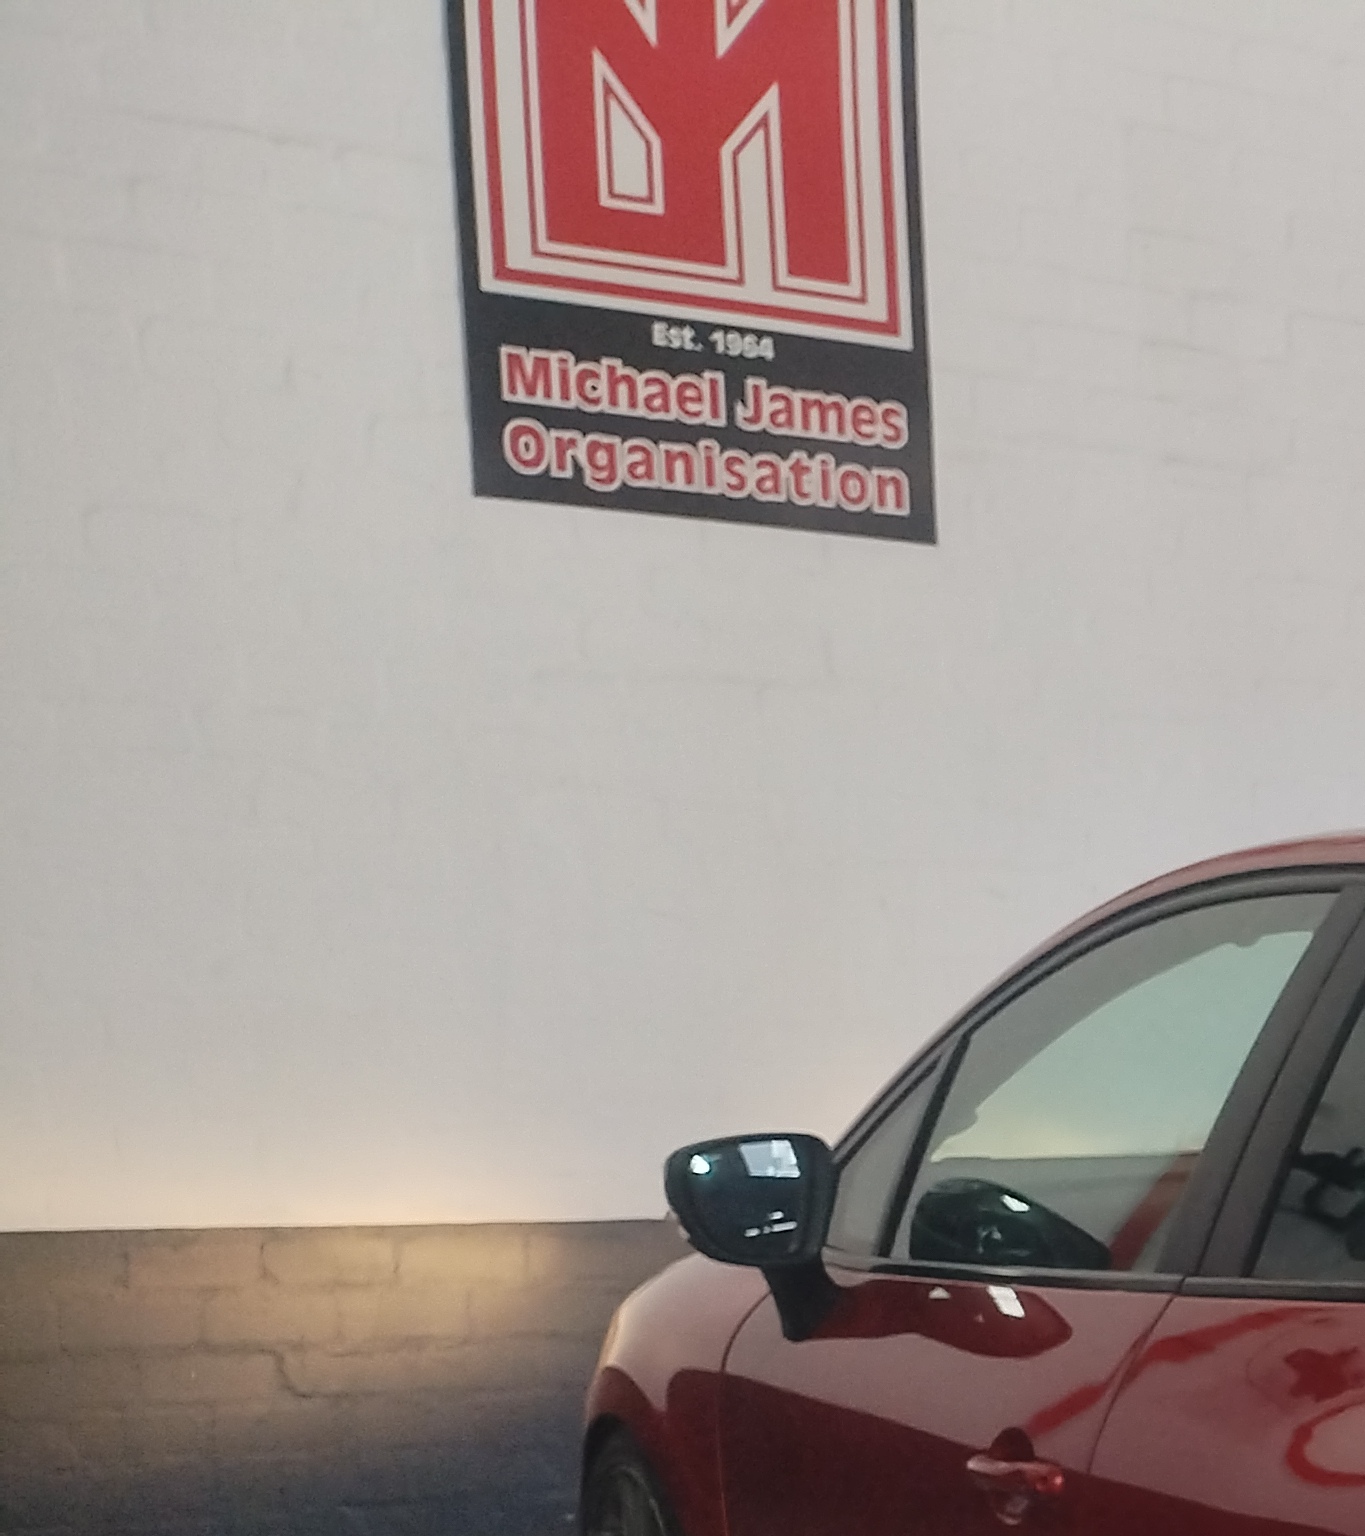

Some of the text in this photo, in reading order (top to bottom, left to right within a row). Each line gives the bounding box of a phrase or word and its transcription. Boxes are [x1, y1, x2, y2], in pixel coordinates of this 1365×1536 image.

[652, 321, 776, 361] Est. 1964
[501, 344, 910, 450] Michael James
[503, 416, 911, 517] Organisation
